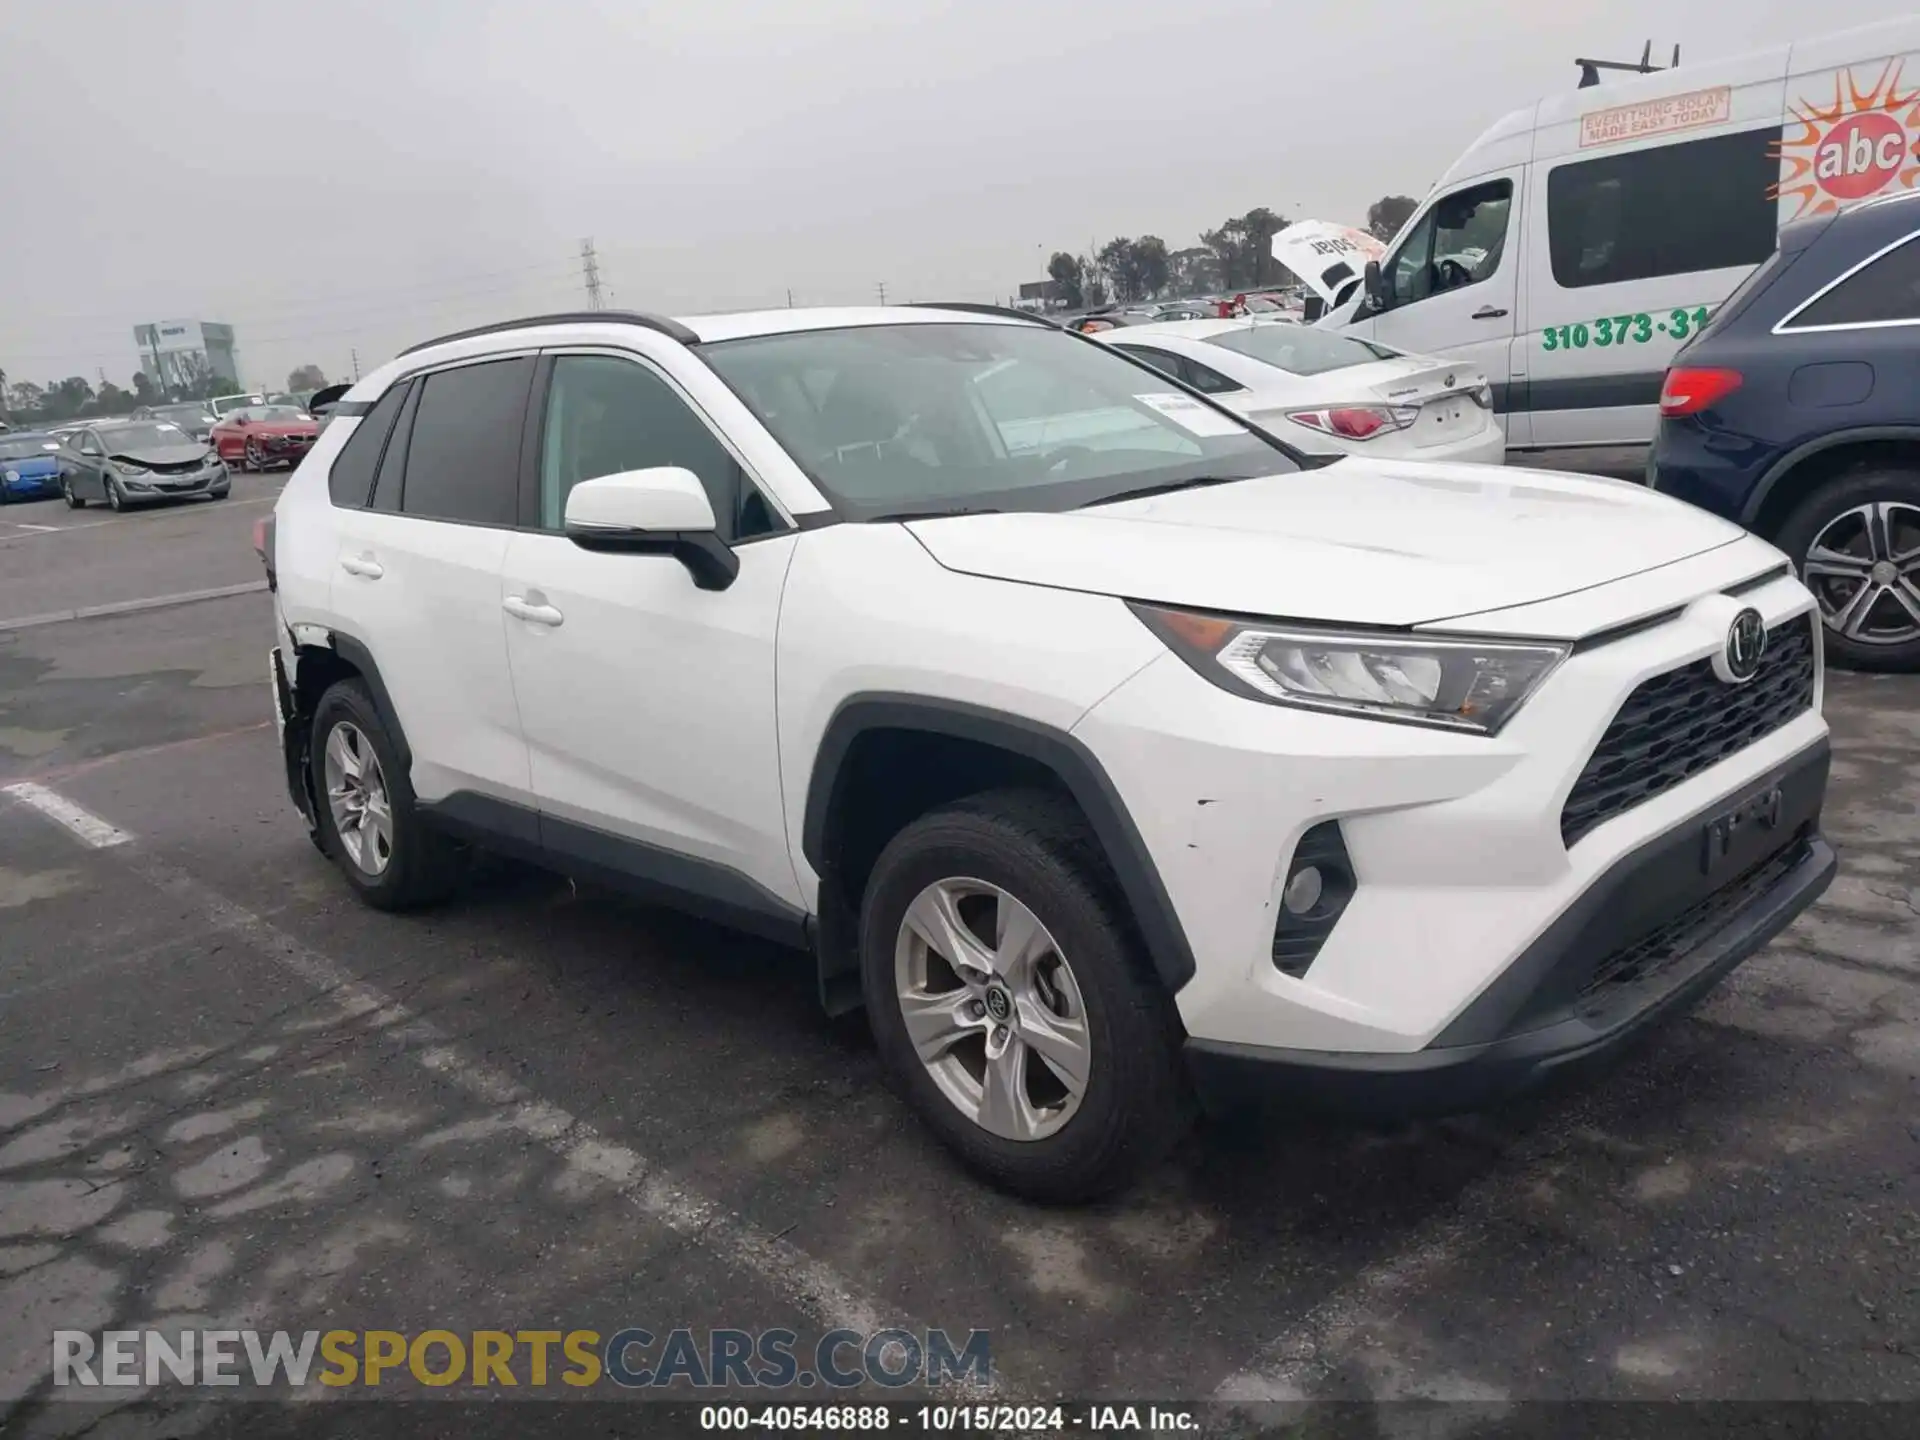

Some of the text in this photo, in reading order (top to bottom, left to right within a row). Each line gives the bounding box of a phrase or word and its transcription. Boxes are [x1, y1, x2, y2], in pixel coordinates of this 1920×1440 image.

[1586, 92, 1724, 130] EVERYTHING SOLAR
[1589, 106, 1718, 140] MADE EASY TODAY
[1818, 127, 1902, 179] abc
[1542, 323, 1589, 351] 310
